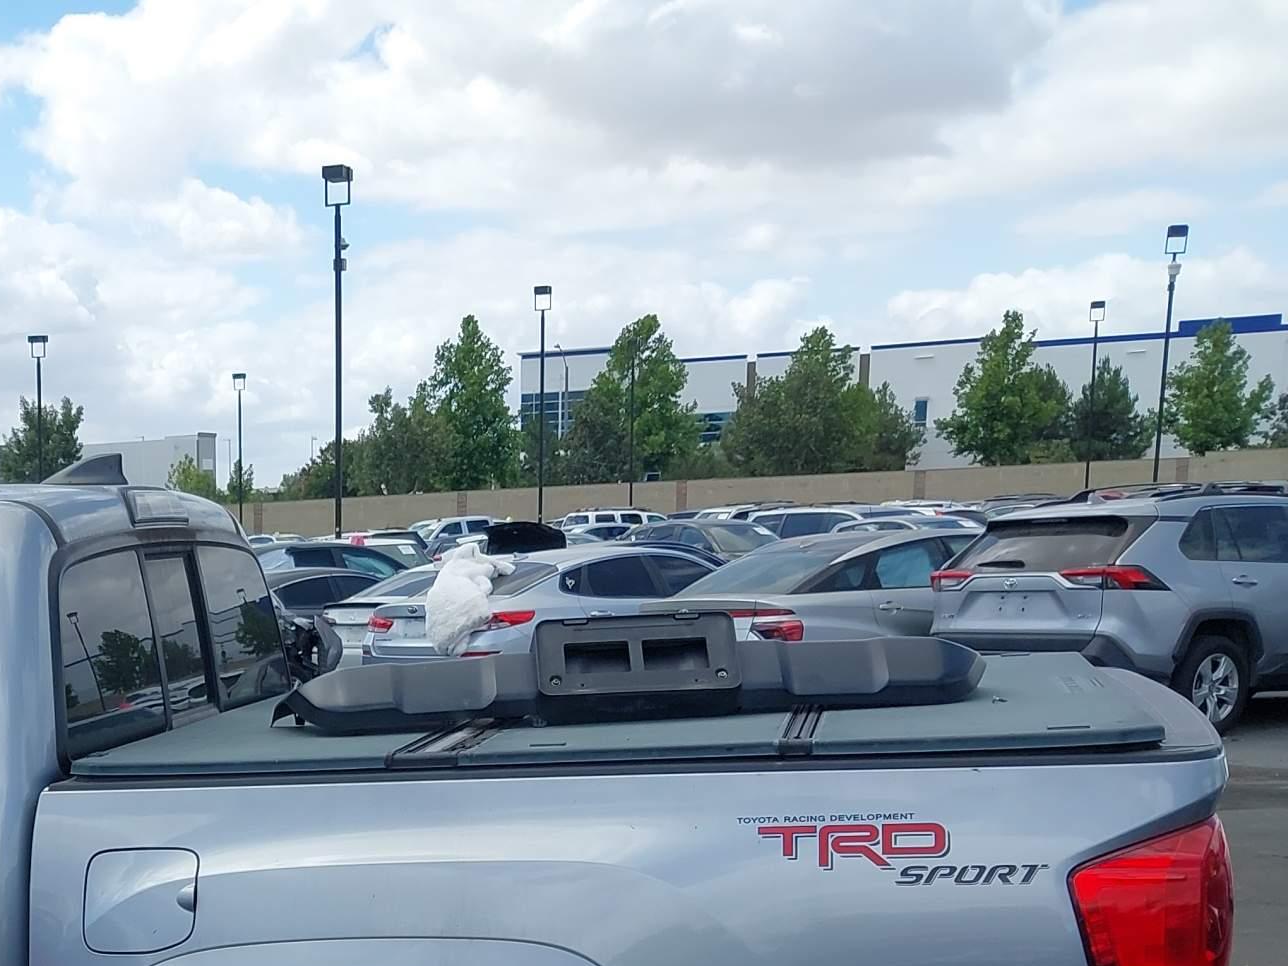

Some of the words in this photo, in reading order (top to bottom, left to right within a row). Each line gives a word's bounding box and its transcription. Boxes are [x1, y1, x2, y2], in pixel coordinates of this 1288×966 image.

[736, 816, 780, 825] TOYOTA
[783, 815, 826, 823] RACING
[829, 812, 915, 822] DEVELOPMENT
[758, 822, 950, 870] TRD
[894, 863, 1049, 886] SPORT
